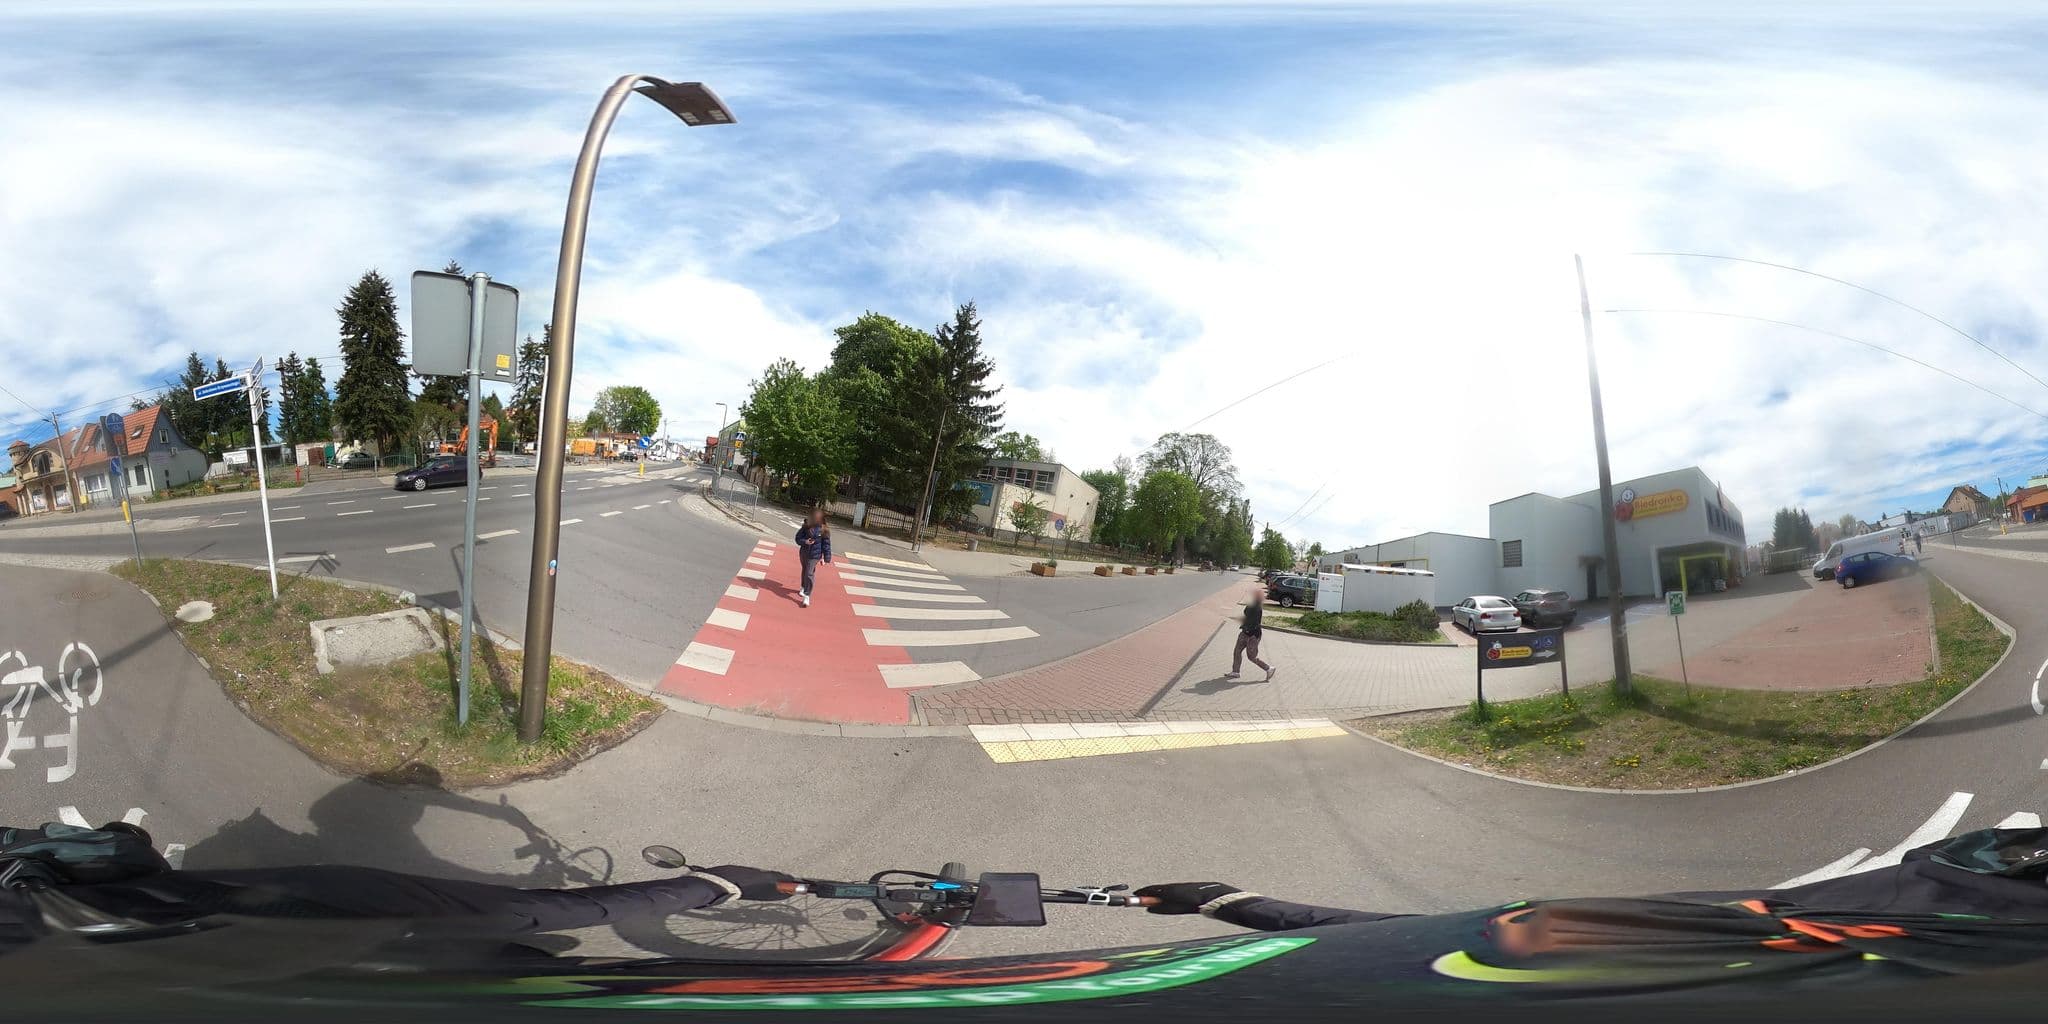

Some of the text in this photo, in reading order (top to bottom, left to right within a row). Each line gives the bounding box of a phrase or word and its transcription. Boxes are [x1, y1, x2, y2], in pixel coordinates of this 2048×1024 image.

[1634, 494, 1683, 509] Biedronka
[618, 940, 1298, 1007] Map Your Way
